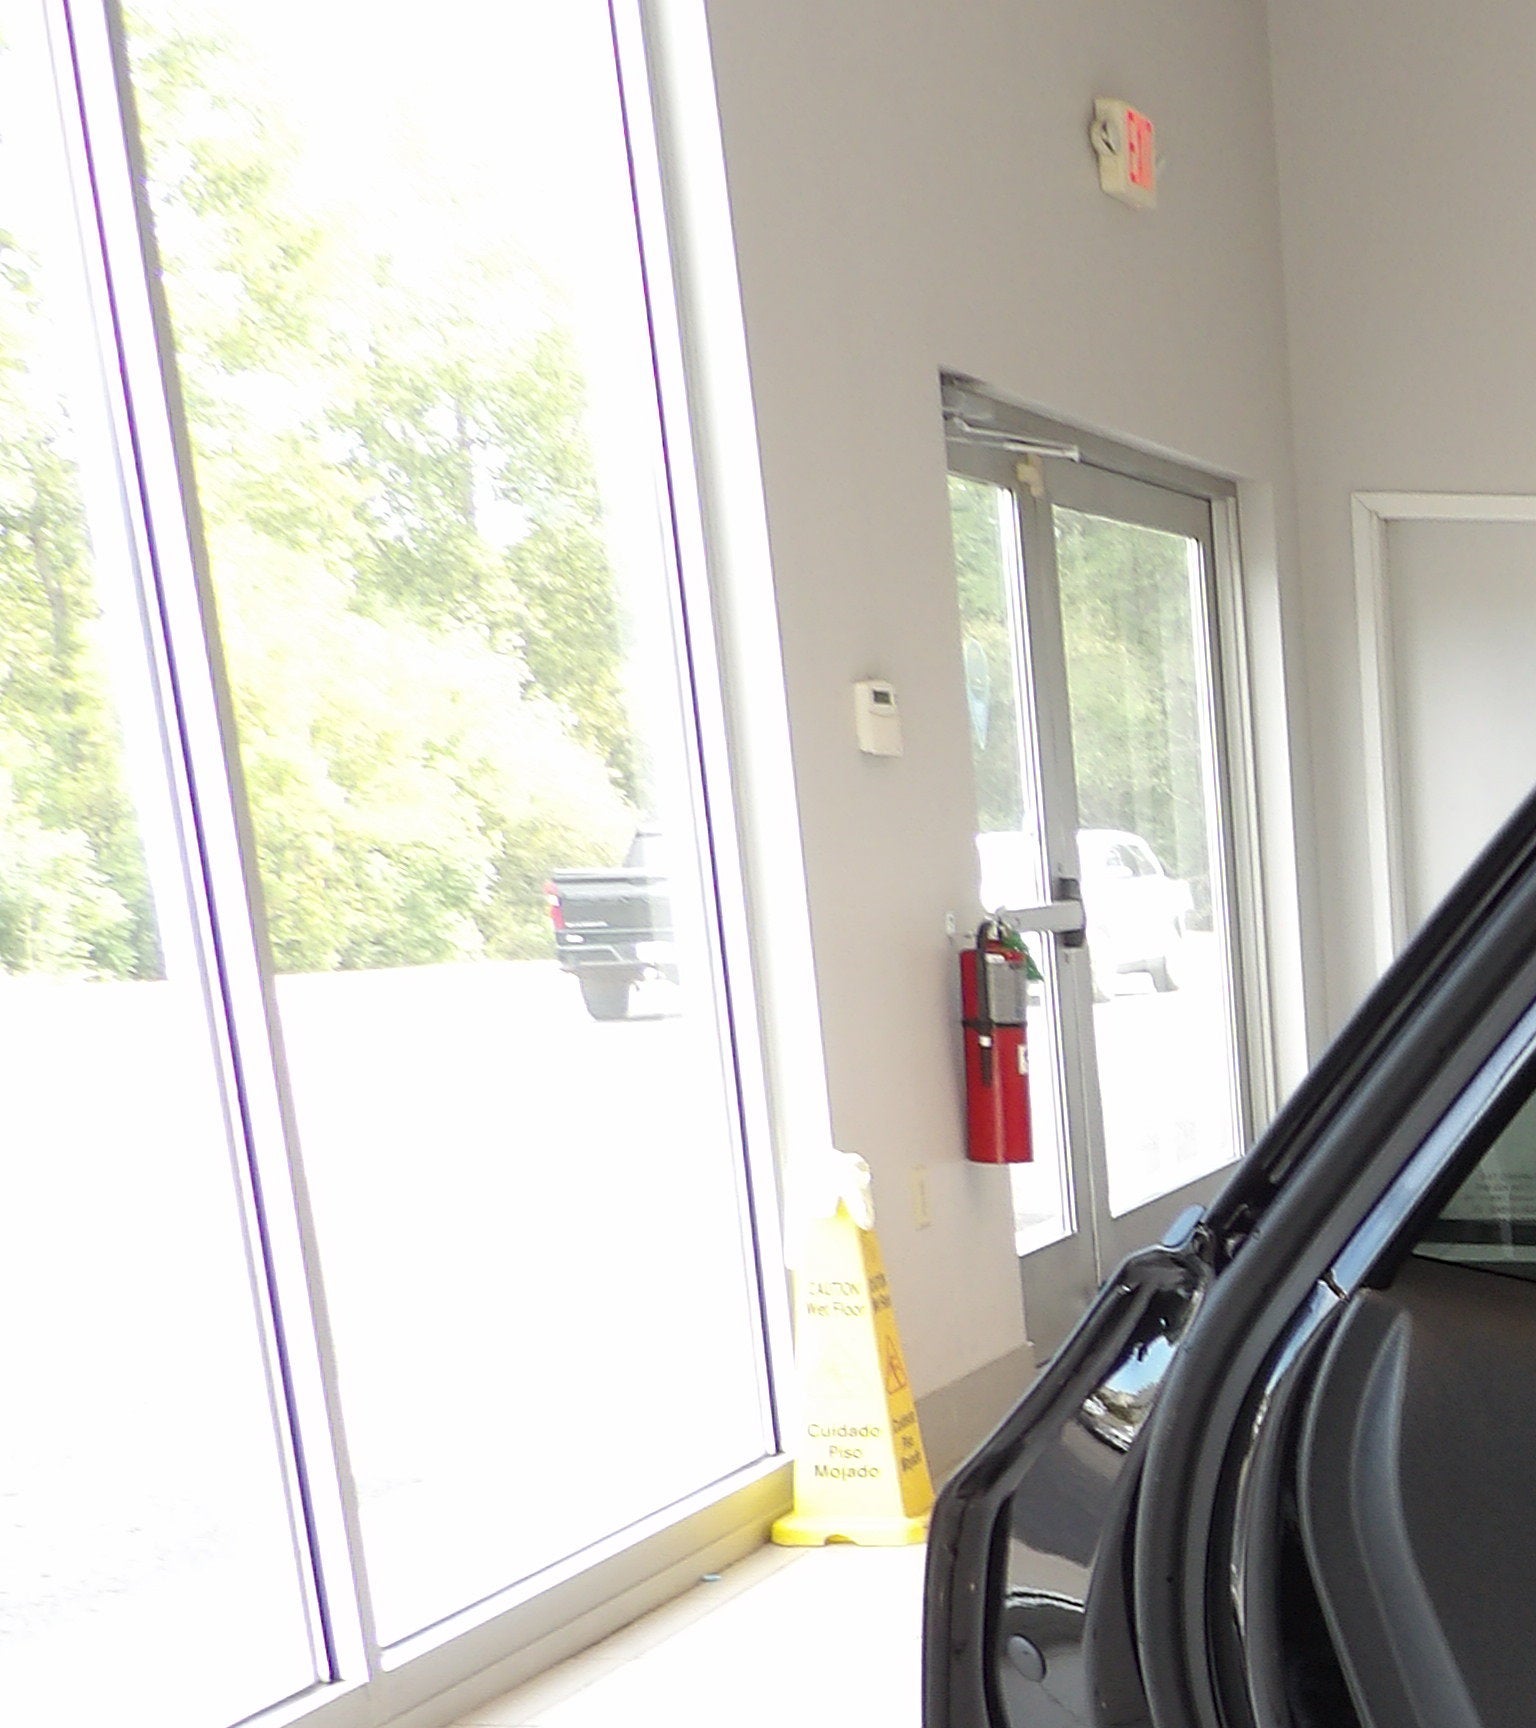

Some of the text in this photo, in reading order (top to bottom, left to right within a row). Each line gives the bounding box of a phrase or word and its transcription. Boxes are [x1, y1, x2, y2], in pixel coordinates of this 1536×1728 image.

[807, 1423, 880, 1438] Cuidado
[829, 1445, 863, 1459] Piso
[814, 1464, 881, 1481] Mojado
